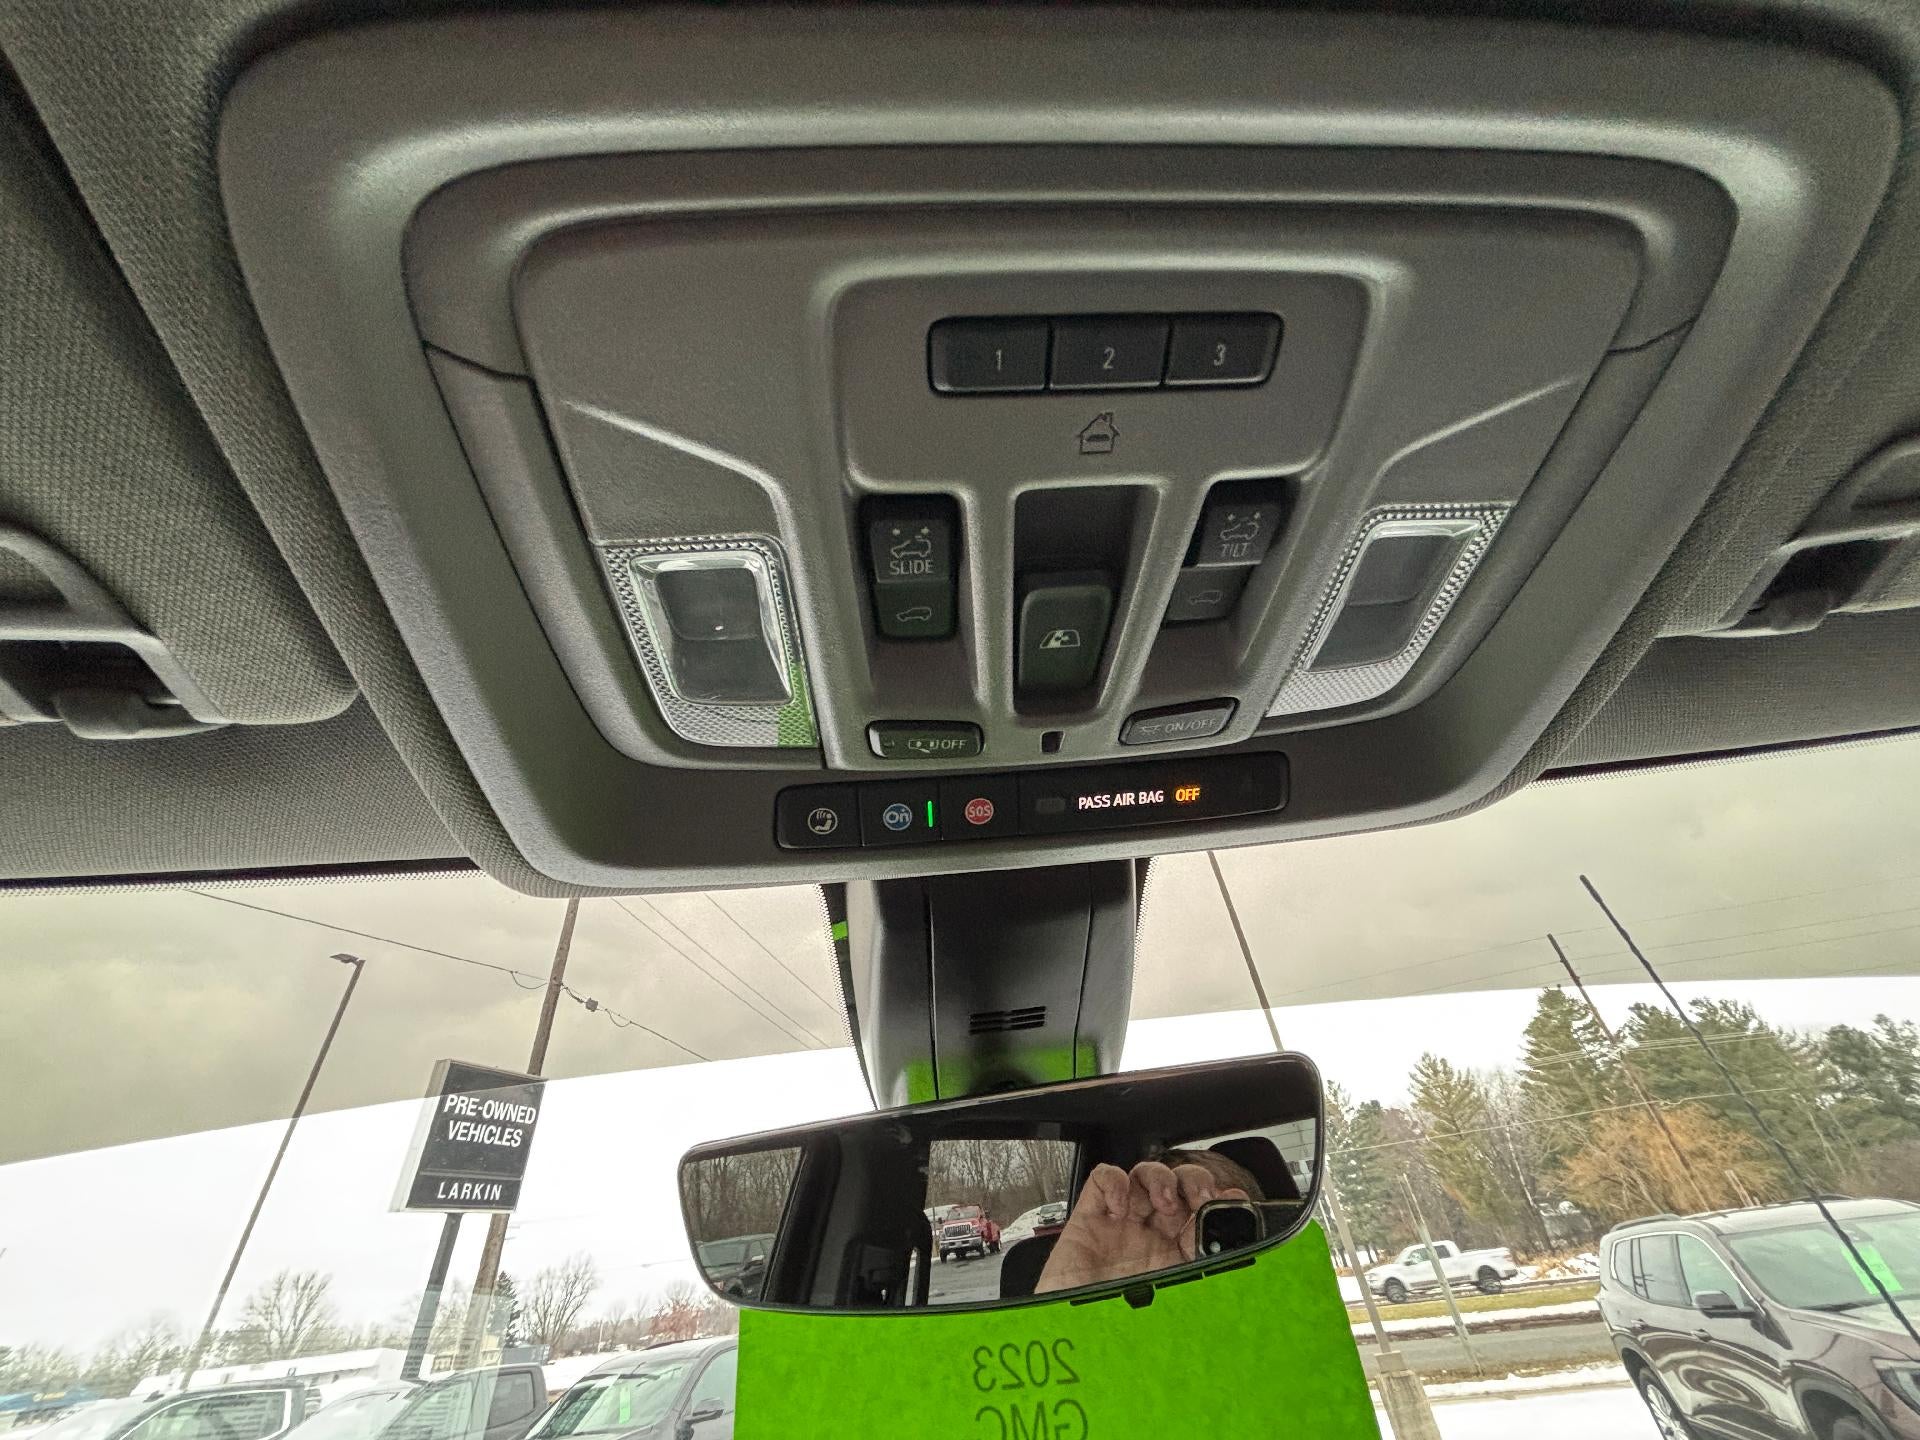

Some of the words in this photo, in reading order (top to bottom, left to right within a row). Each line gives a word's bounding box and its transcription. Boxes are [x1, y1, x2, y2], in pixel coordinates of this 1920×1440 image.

[995, 349, 1003, 371] 1
[1103, 346, 1116, 370] 2
[1213, 342, 1227, 367] 3
[1221, 541, 1251, 558] TILT
[889, 559, 934, 576] SLIDE
[1164, 718, 1216, 734] ON/OFF
[941, 739, 968, 750] OFF
[1078, 794, 1111, 810] PASS
[1113, 792, 1136, 807] AIR
[1138, 790, 1164, 805] BAG
[1175, 787, 1200, 802] OFF
[968, 804, 991, 819] SOS
[443, 1094, 537, 1125] PRE-OWNED
[448, 1120, 523, 1148] VEHICLES
[437, 1181, 503, 1201] LARKIN
